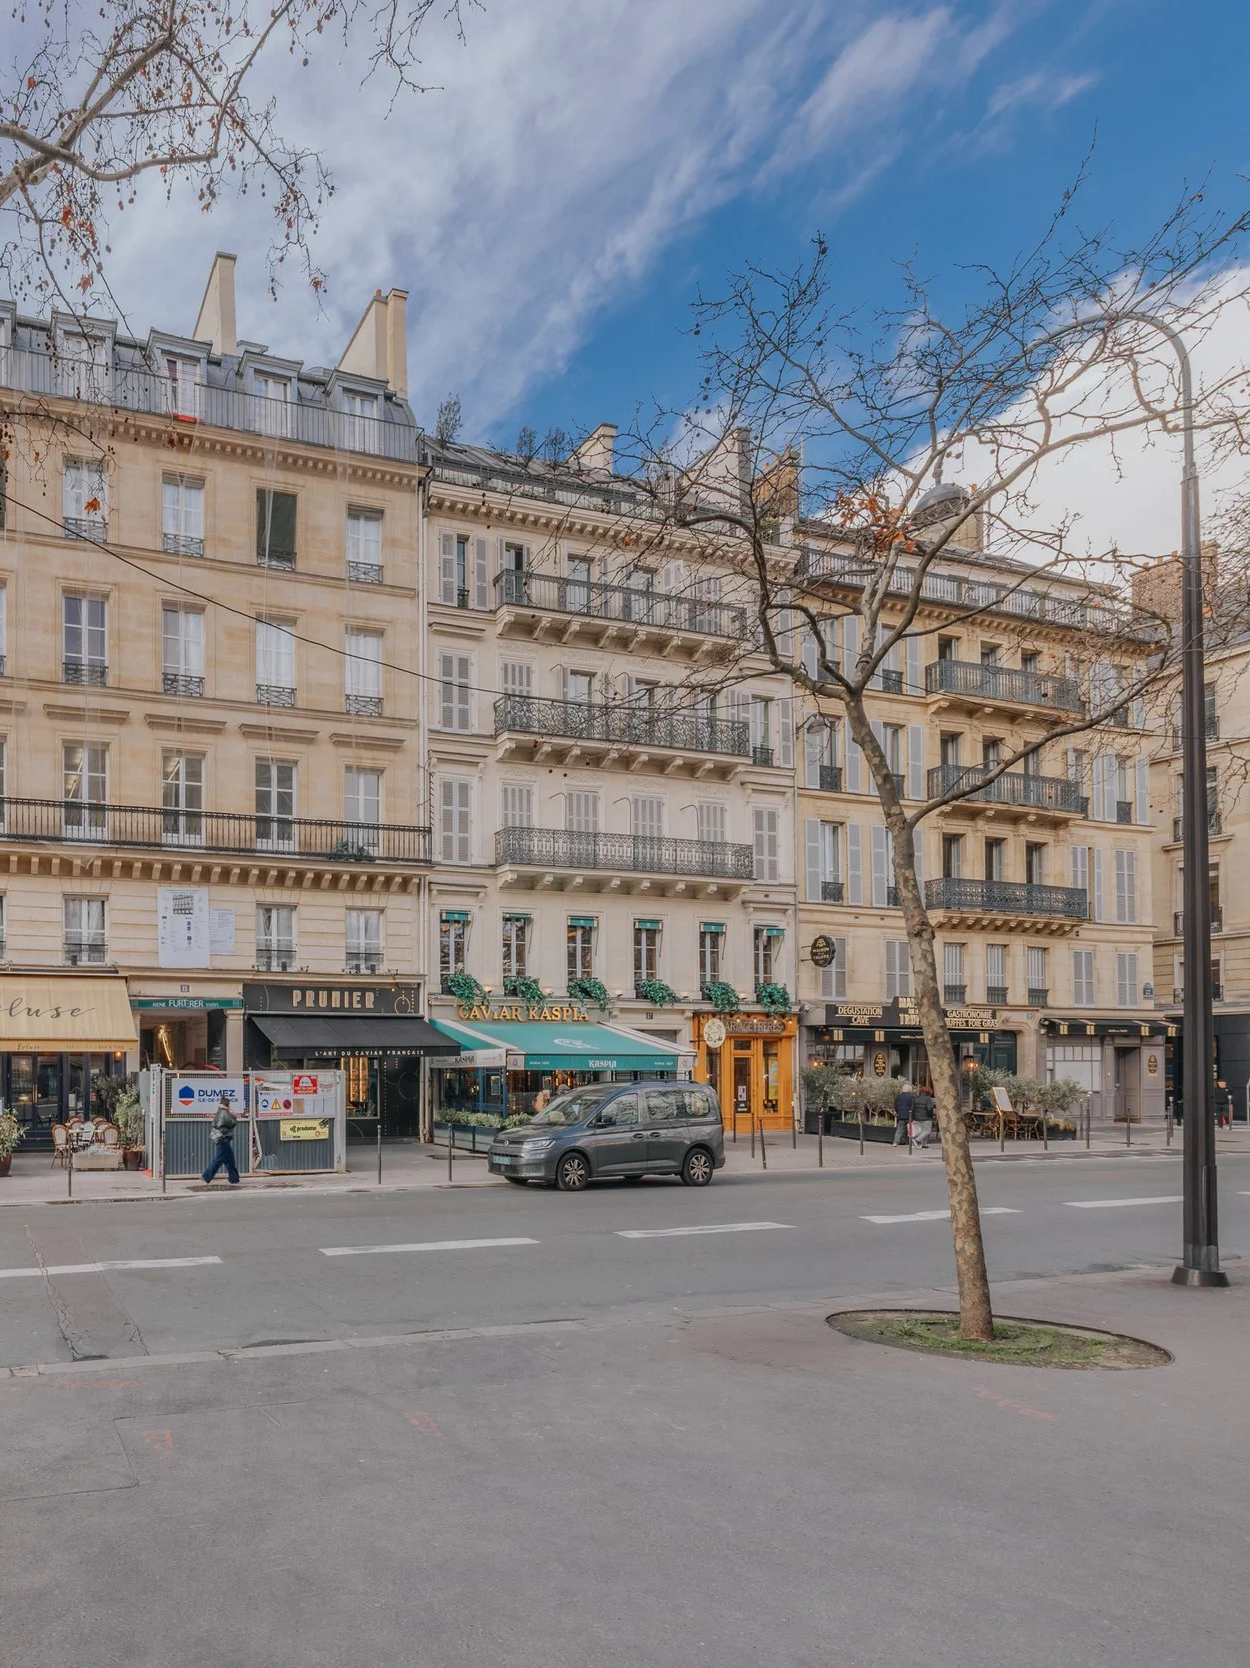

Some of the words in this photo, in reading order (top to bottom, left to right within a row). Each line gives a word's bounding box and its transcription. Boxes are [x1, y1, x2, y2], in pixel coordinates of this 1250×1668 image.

[168, 999, 204, 1008] FURTERER
[292, 989, 375, 1009] PRUNIER
[457, 1004, 523, 1022] CAVIAR
[528, 1005, 590, 1021] KASPIA
[837, 1006, 883, 1015] DEGUSTATION
[947, 1010, 993, 1018] GASTRONOMIE
[852, 1015, 870, 1024] CAVE
[946, 1019, 967, 1028] UFFES
[968, 1019, 982, 1028] FOIE
[982, 1019, 999, 1028] GRAS
[725, 1021, 752, 1031] ARIAGE
[454, 1055, 476, 1064] KASPIA
[588, 1060, 617, 1069] KASPIA
[198, 1089, 236, 1097] DUMEZ
